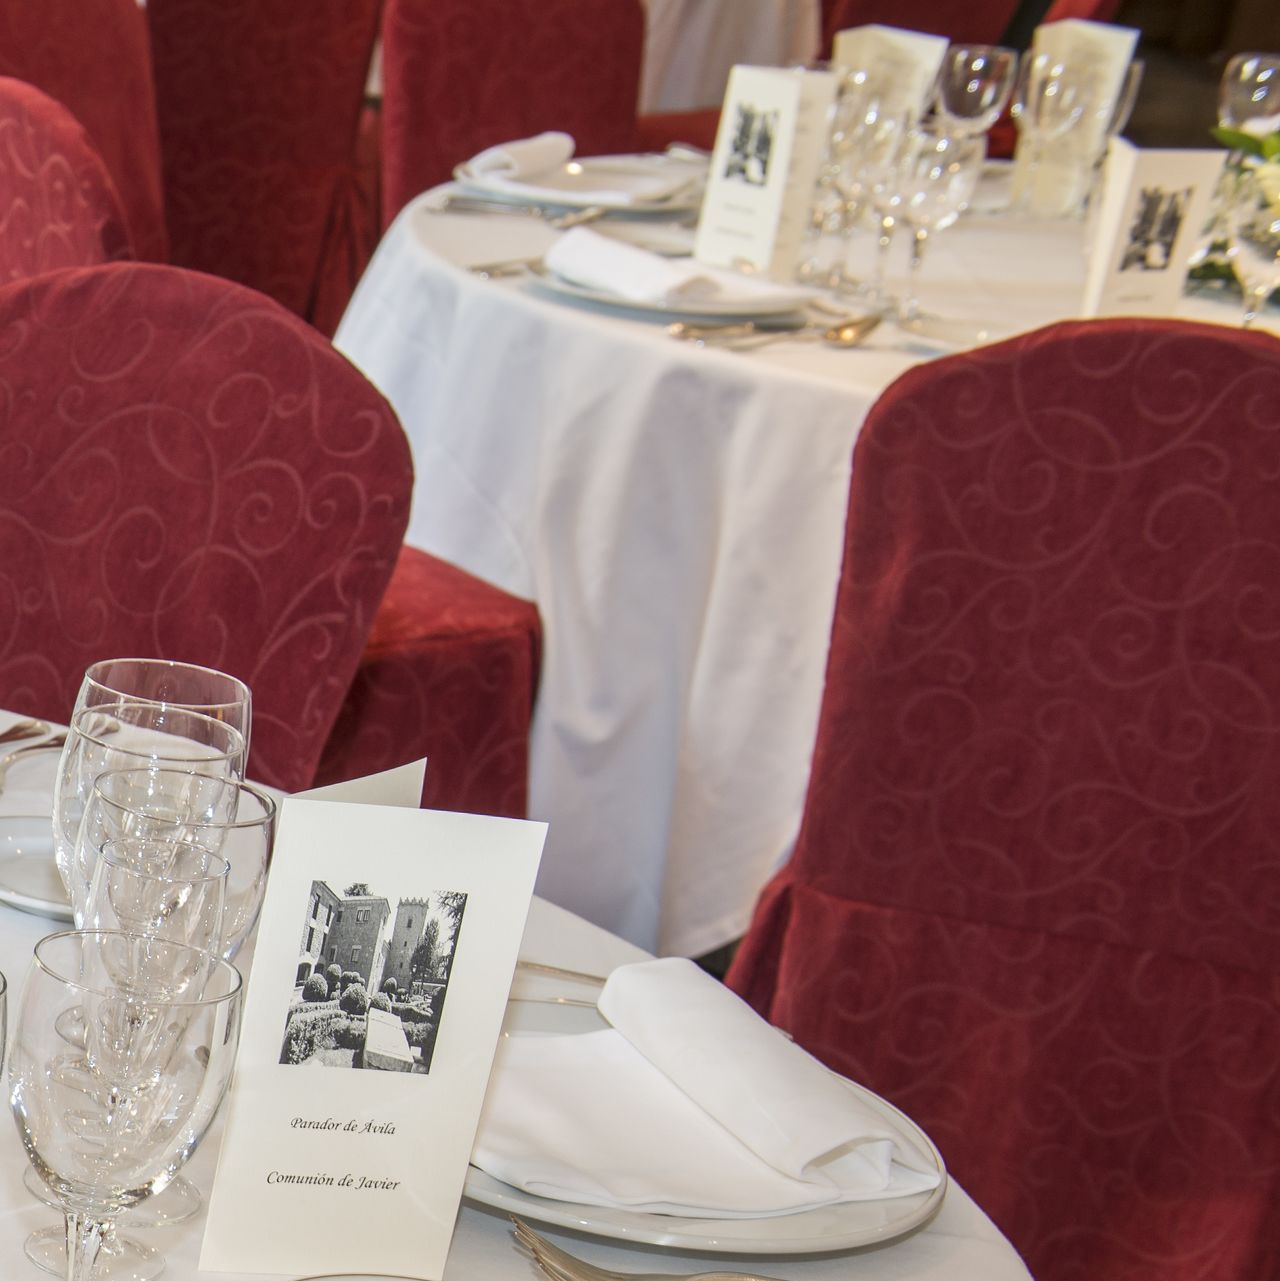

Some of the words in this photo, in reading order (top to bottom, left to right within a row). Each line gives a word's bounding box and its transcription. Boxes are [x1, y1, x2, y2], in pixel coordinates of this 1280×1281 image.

[290, 1117, 342, 1131] Parador
[344, 1120, 358, 1132] de
[358, 1119, 396, 1135] Ávila
[267, 1171, 334, 1186] Comunión
[338, 1174, 353, 1187] de
[355, 1176, 401, 1191] Javier
